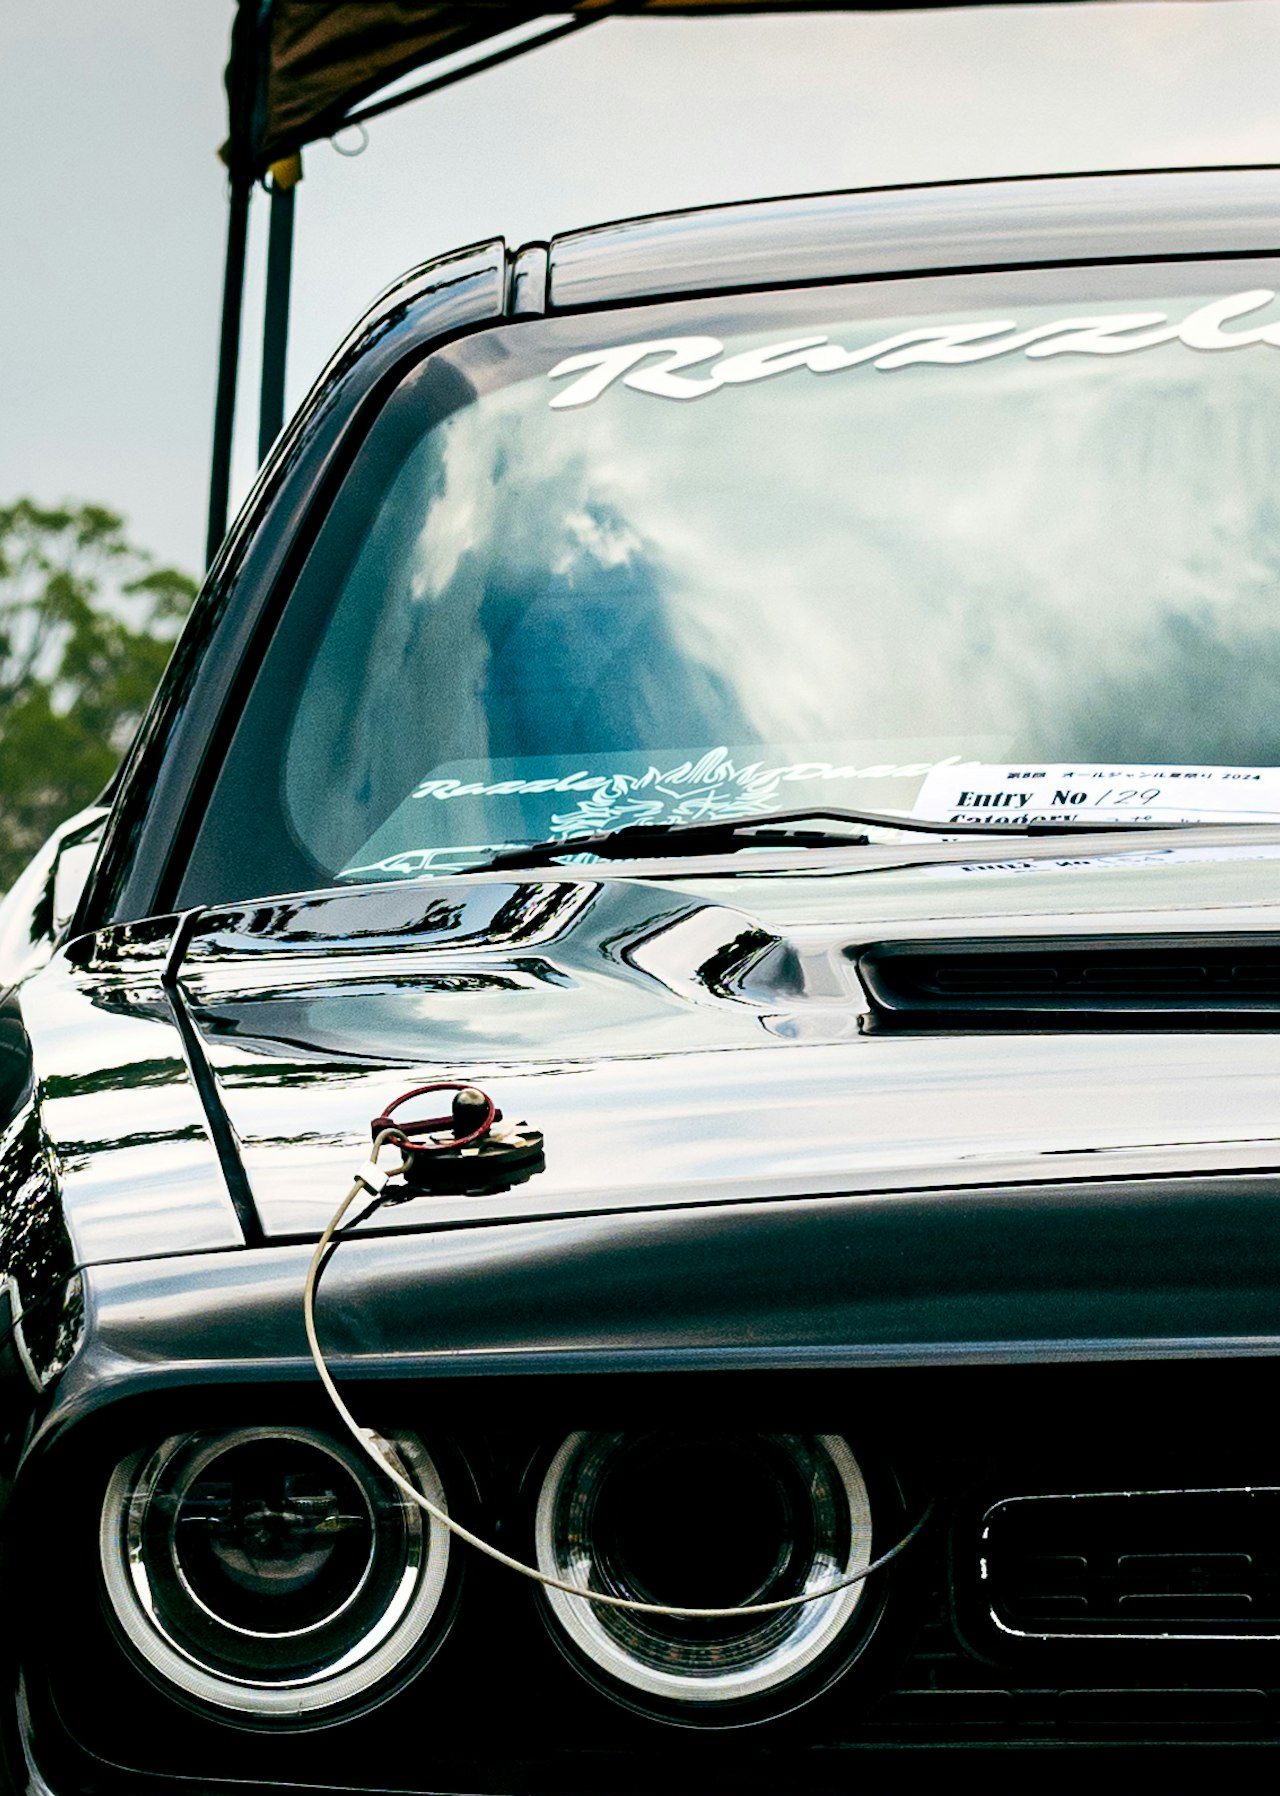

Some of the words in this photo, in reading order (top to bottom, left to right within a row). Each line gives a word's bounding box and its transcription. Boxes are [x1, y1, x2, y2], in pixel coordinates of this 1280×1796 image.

[1222, 772, 1261, 781] 2024
[955, 791, 1035, 809] Entry
[1050, 789, 1088, 806] No
